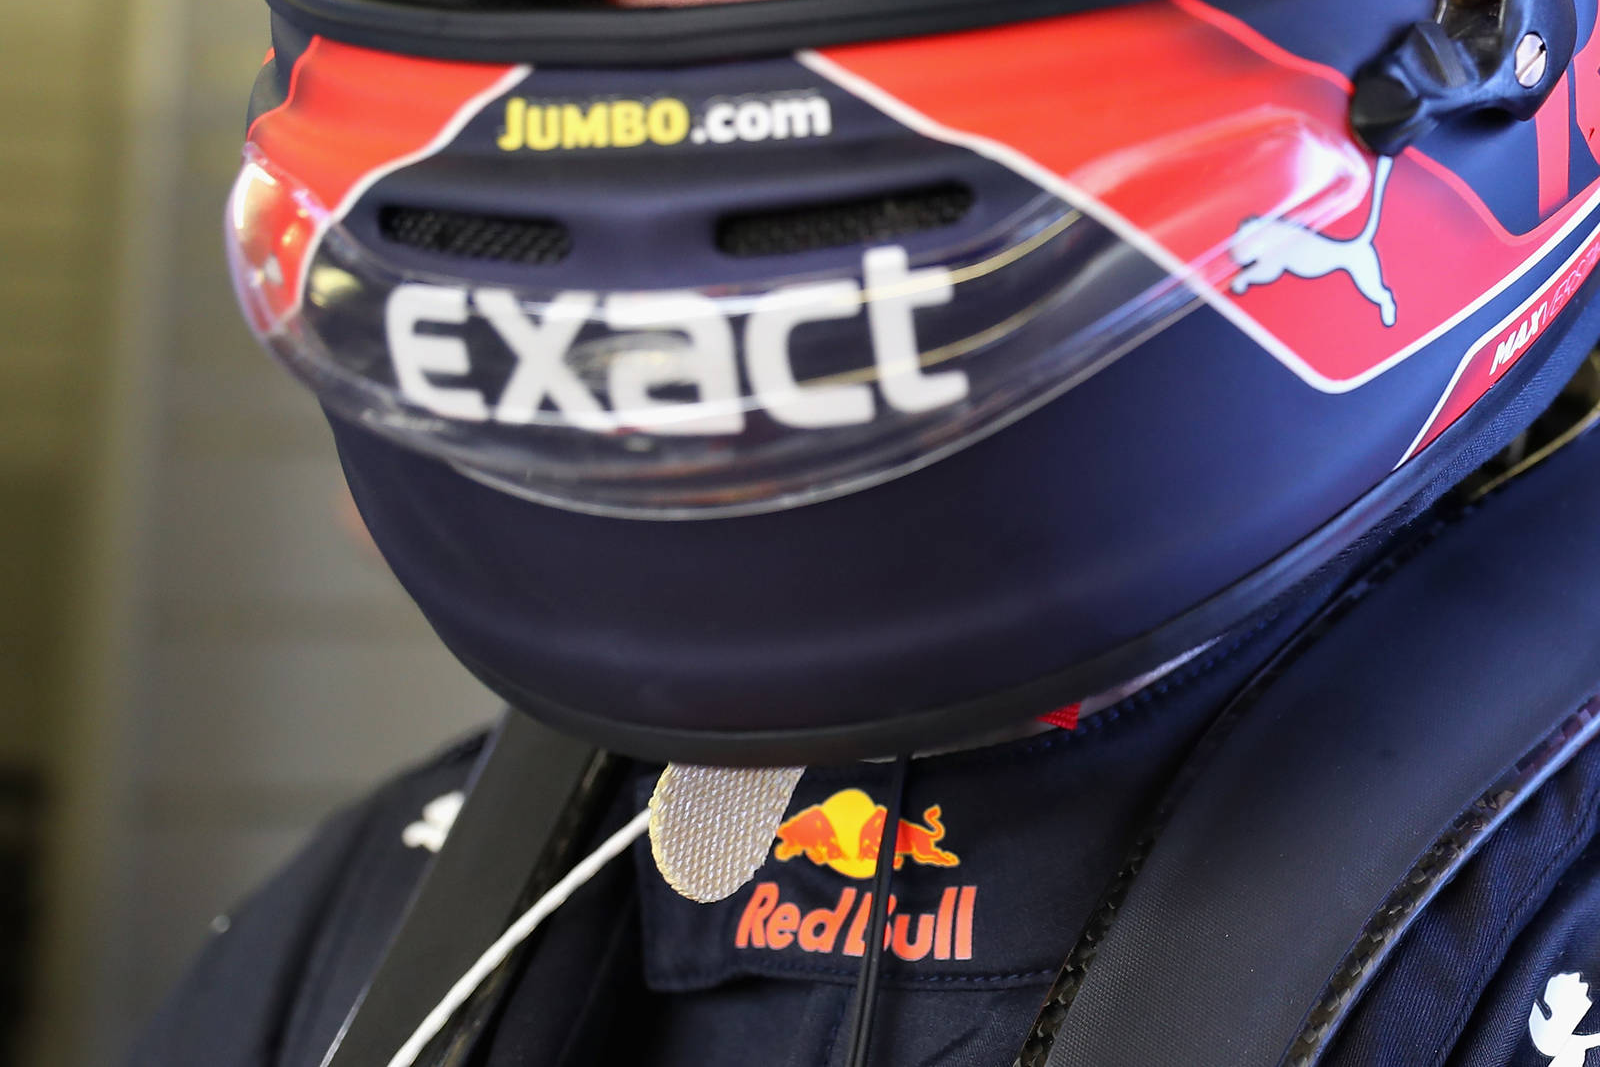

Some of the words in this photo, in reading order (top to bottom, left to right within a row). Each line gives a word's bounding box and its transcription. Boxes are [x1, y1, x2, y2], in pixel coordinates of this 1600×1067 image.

[497, 96, 832, 152] JUMBO.com
[1489, 303, 1547, 375] MAX
[735, 882, 858, 954] Red
